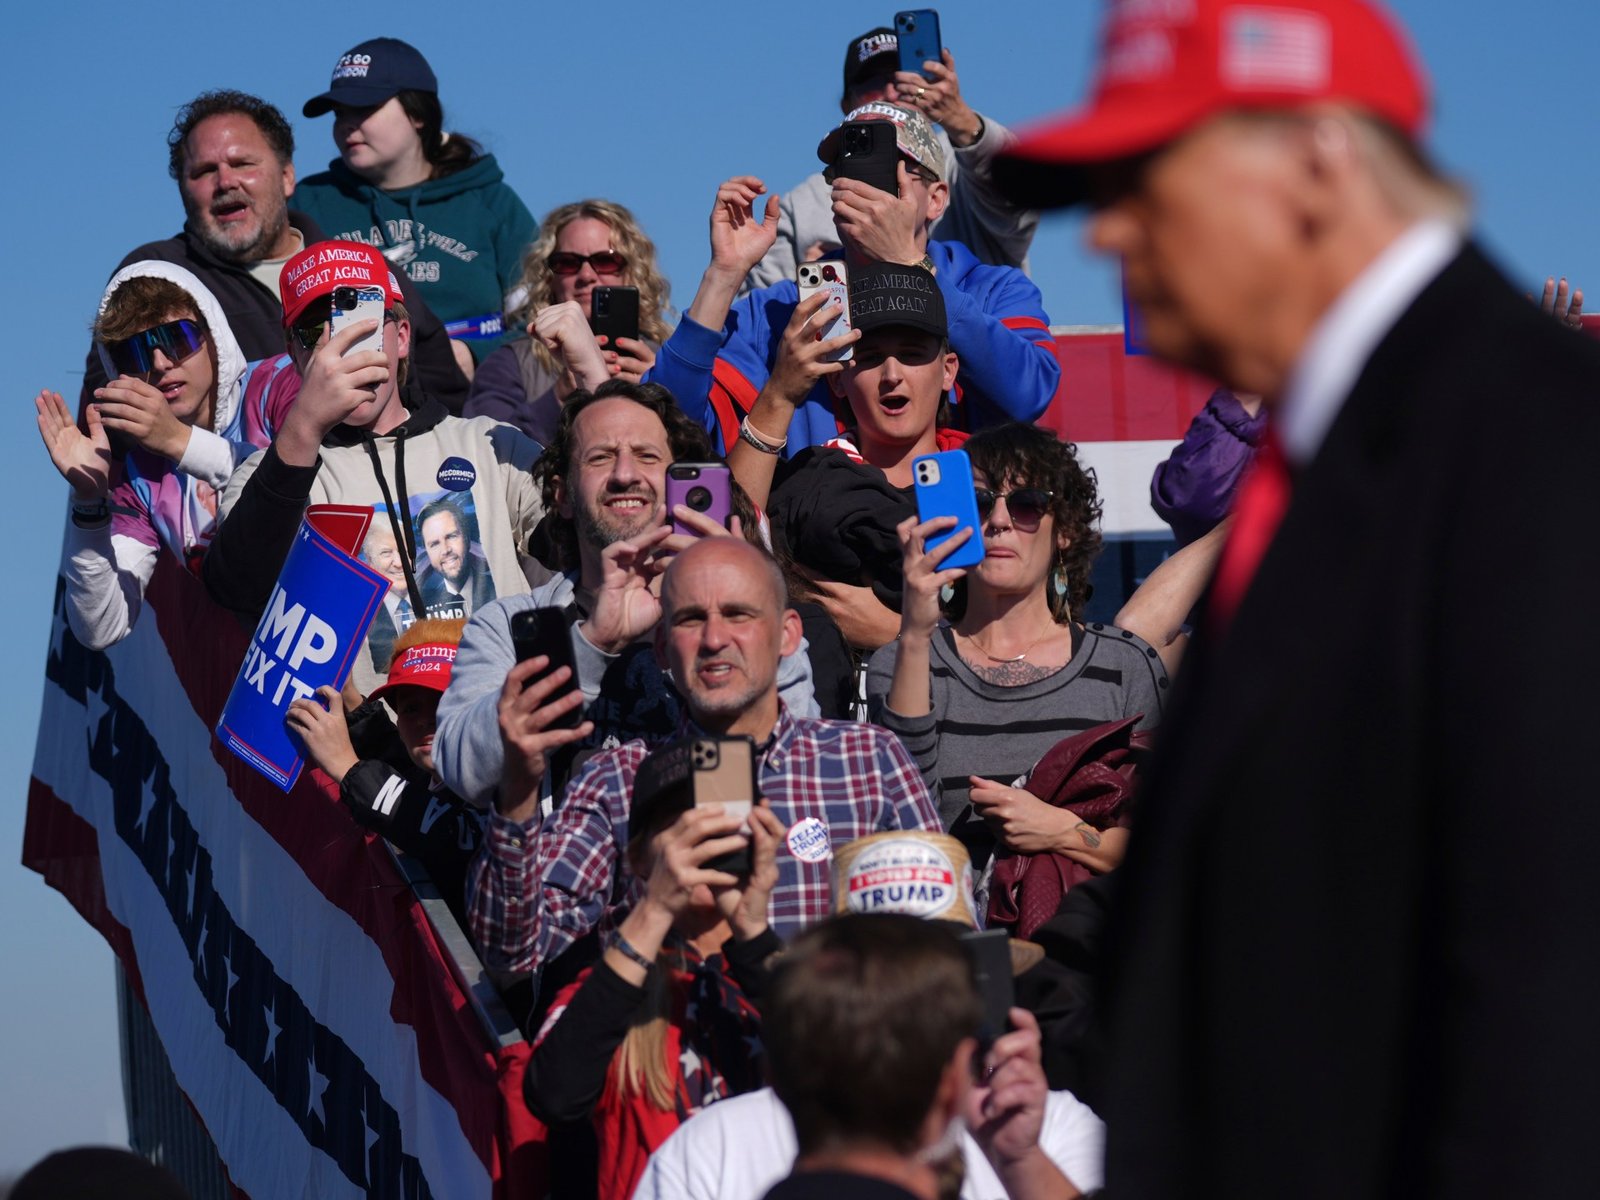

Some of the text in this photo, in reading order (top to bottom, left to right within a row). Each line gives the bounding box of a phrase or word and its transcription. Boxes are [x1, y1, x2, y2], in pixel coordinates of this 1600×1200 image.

[353, 54, 371, 65] GO
[287, 249, 374, 285] MAKE AMERICA
[296, 266, 371, 297] GREAT AGAIN
[872, 274, 933, 294] AMERICA
[851, 297, 884, 318] REAT
[887, 295, 929, 313] AGAIN
[402, 608, 465, 629] TUMP
[406, 647, 457, 661] Trump
[413, 662, 441, 673] 2024
[861, 885, 943, 912] TRUMP
